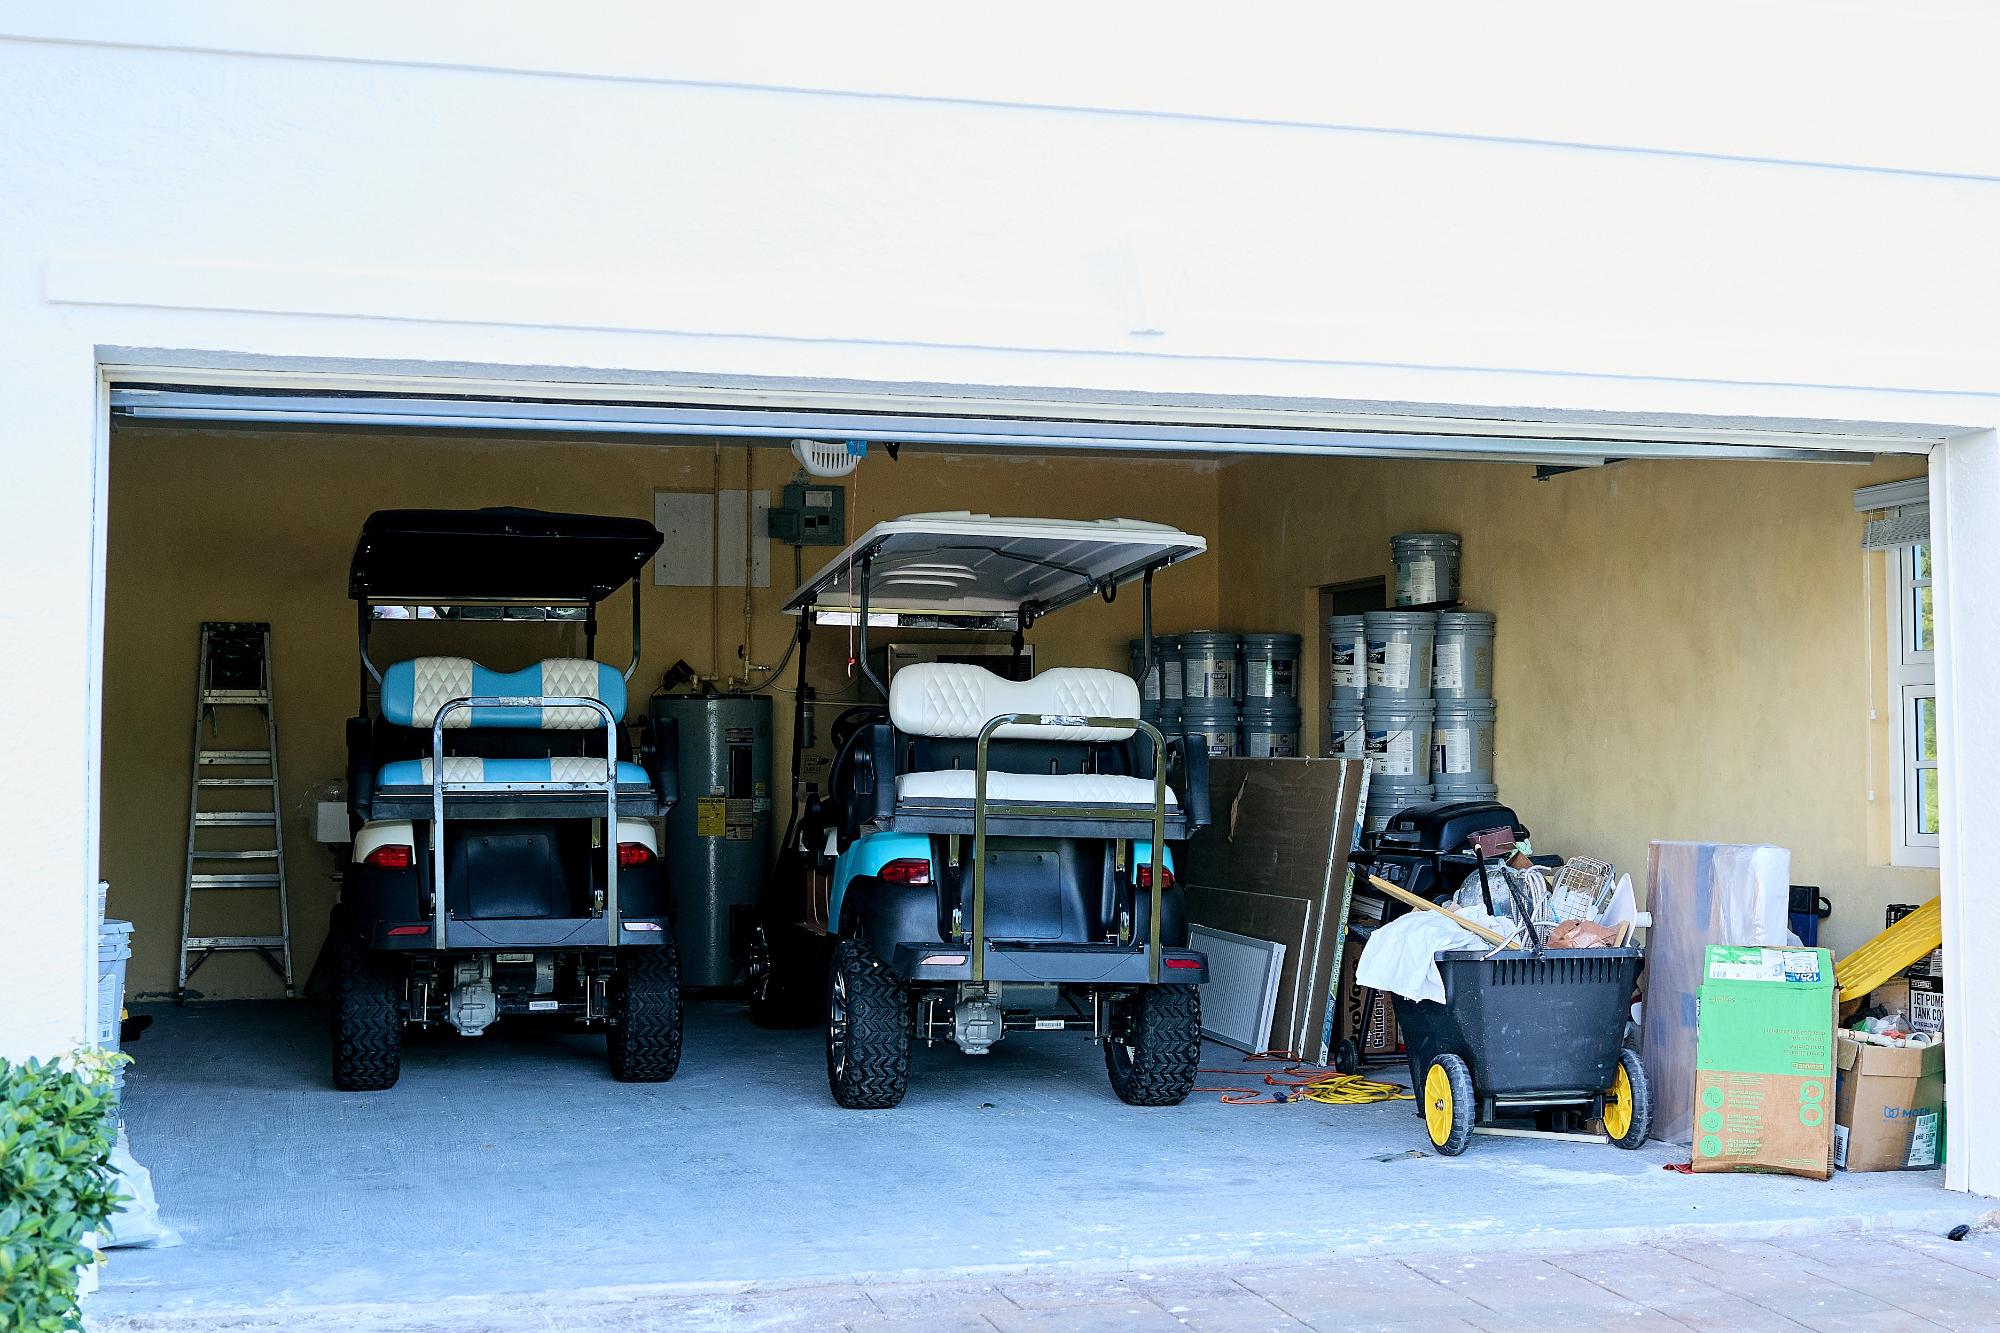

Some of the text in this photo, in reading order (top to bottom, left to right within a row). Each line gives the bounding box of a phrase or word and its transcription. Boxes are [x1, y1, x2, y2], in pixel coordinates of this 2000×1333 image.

[1913, 992, 1925, 1006] JET
[1914, 1007, 1944, 1021] TANK CO
[1372, 1001, 1385, 1047] Grinder
[1902, 1108, 1931, 1118] MOEN
